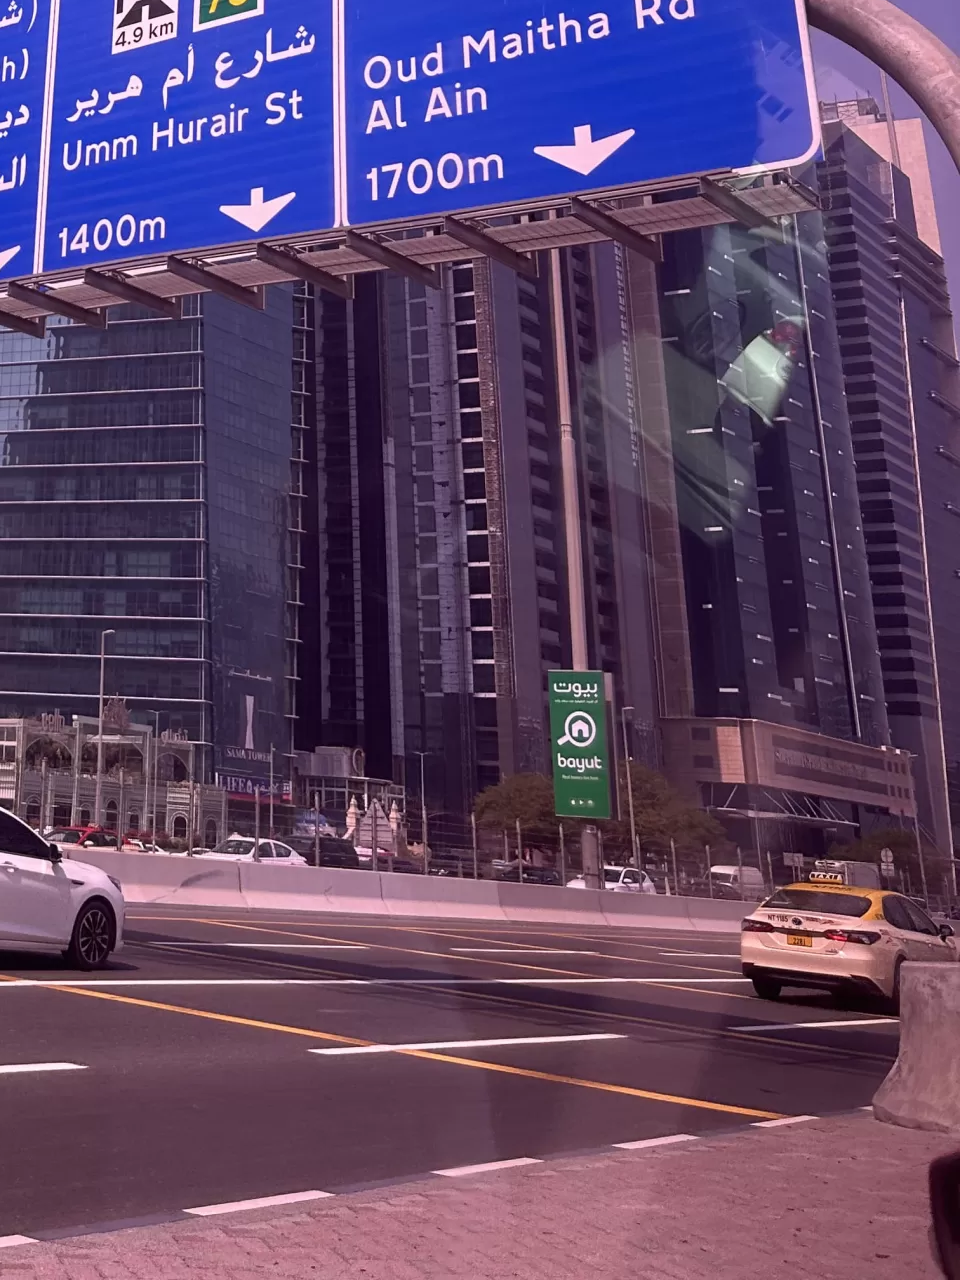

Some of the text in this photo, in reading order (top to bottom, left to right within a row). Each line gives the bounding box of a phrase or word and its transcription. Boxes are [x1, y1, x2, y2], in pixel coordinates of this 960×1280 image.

[114, 18, 174, 49] 4.9 km
[363, 41, 443, 90] Oud
[462, 7, 610, 70] Maitha
[66, 24, 316, 123] شارع أم هرير
[62, 87, 303, 172] Umm Hurair St
[365, 81, 488, 135] Al Ain
[366, 150, 504, 202] 1700m
[58, 213, 166, 258] 1400m
[553, 682, 598, 698] بيوت
[557, 752, 602, 773] bayut
